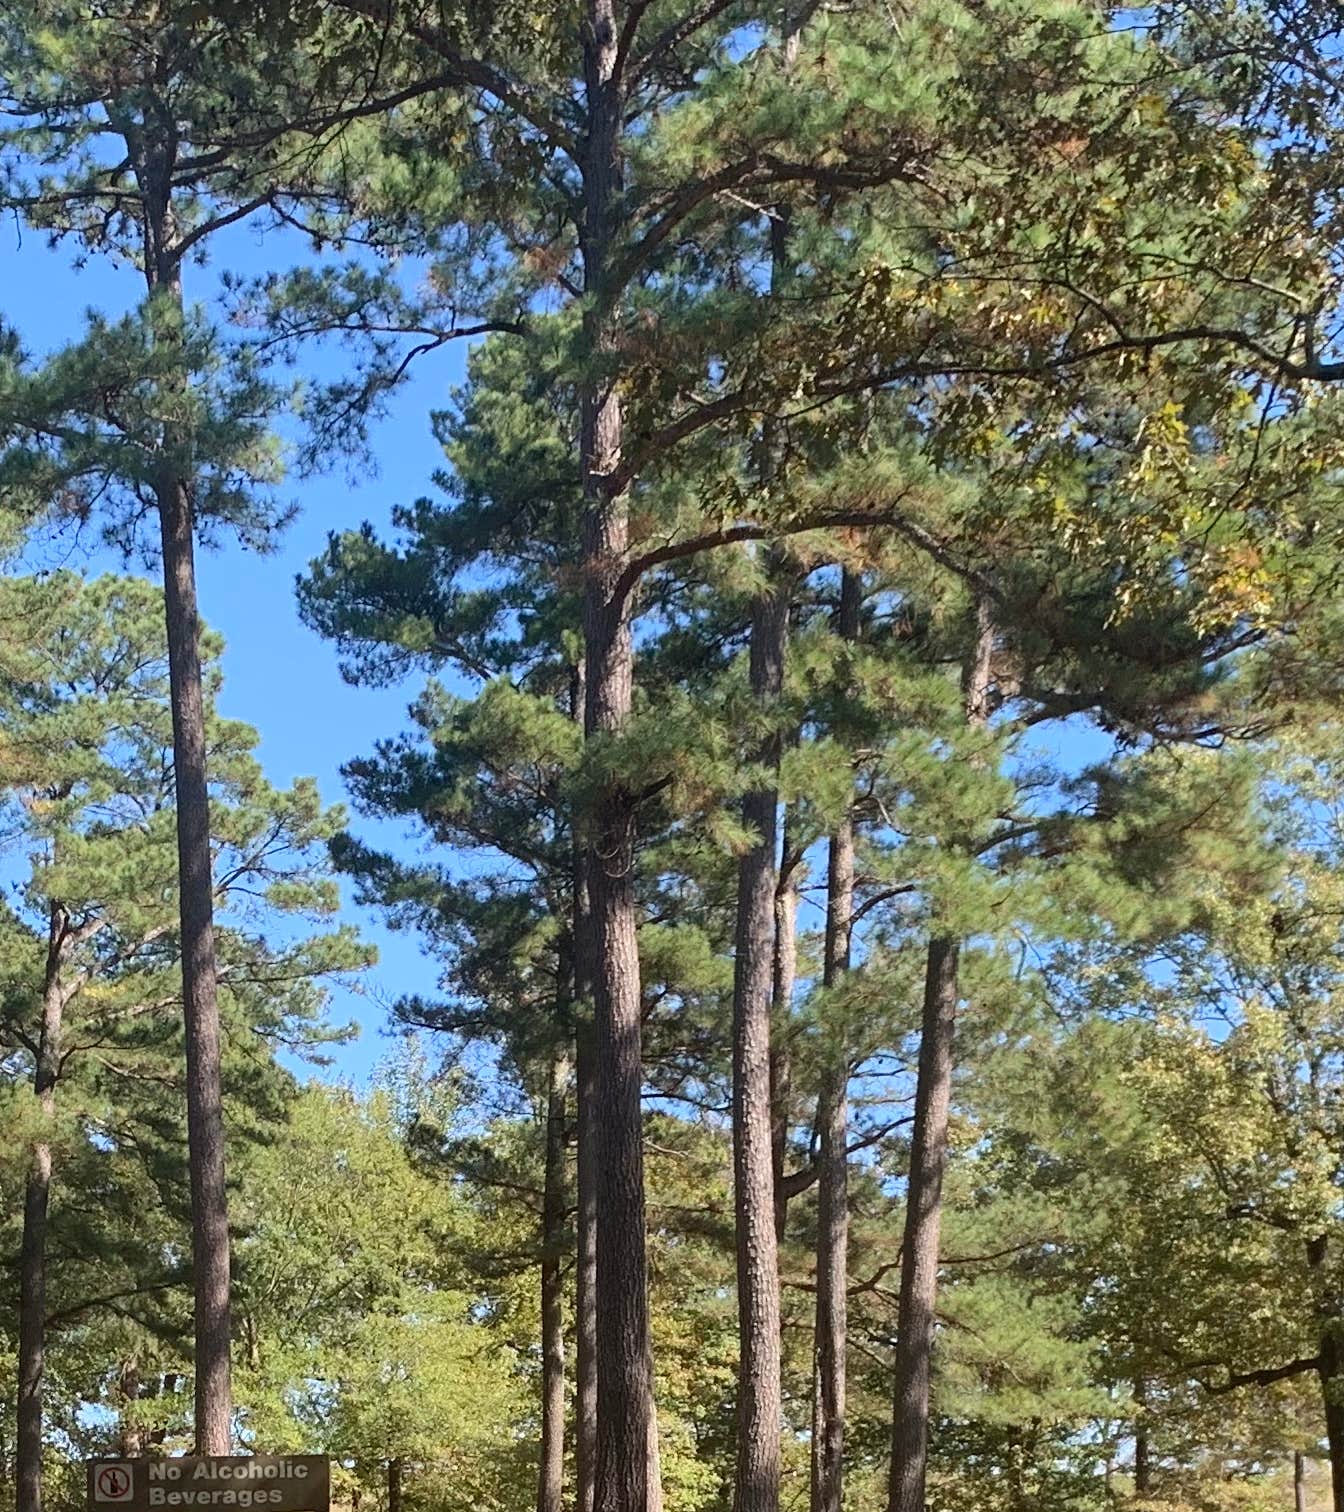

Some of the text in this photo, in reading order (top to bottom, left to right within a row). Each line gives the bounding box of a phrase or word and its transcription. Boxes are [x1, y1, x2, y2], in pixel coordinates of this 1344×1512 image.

[148, 1460, 309, 1481] No Alcoholic
[148, 1487, 283, 1508] Beverages
